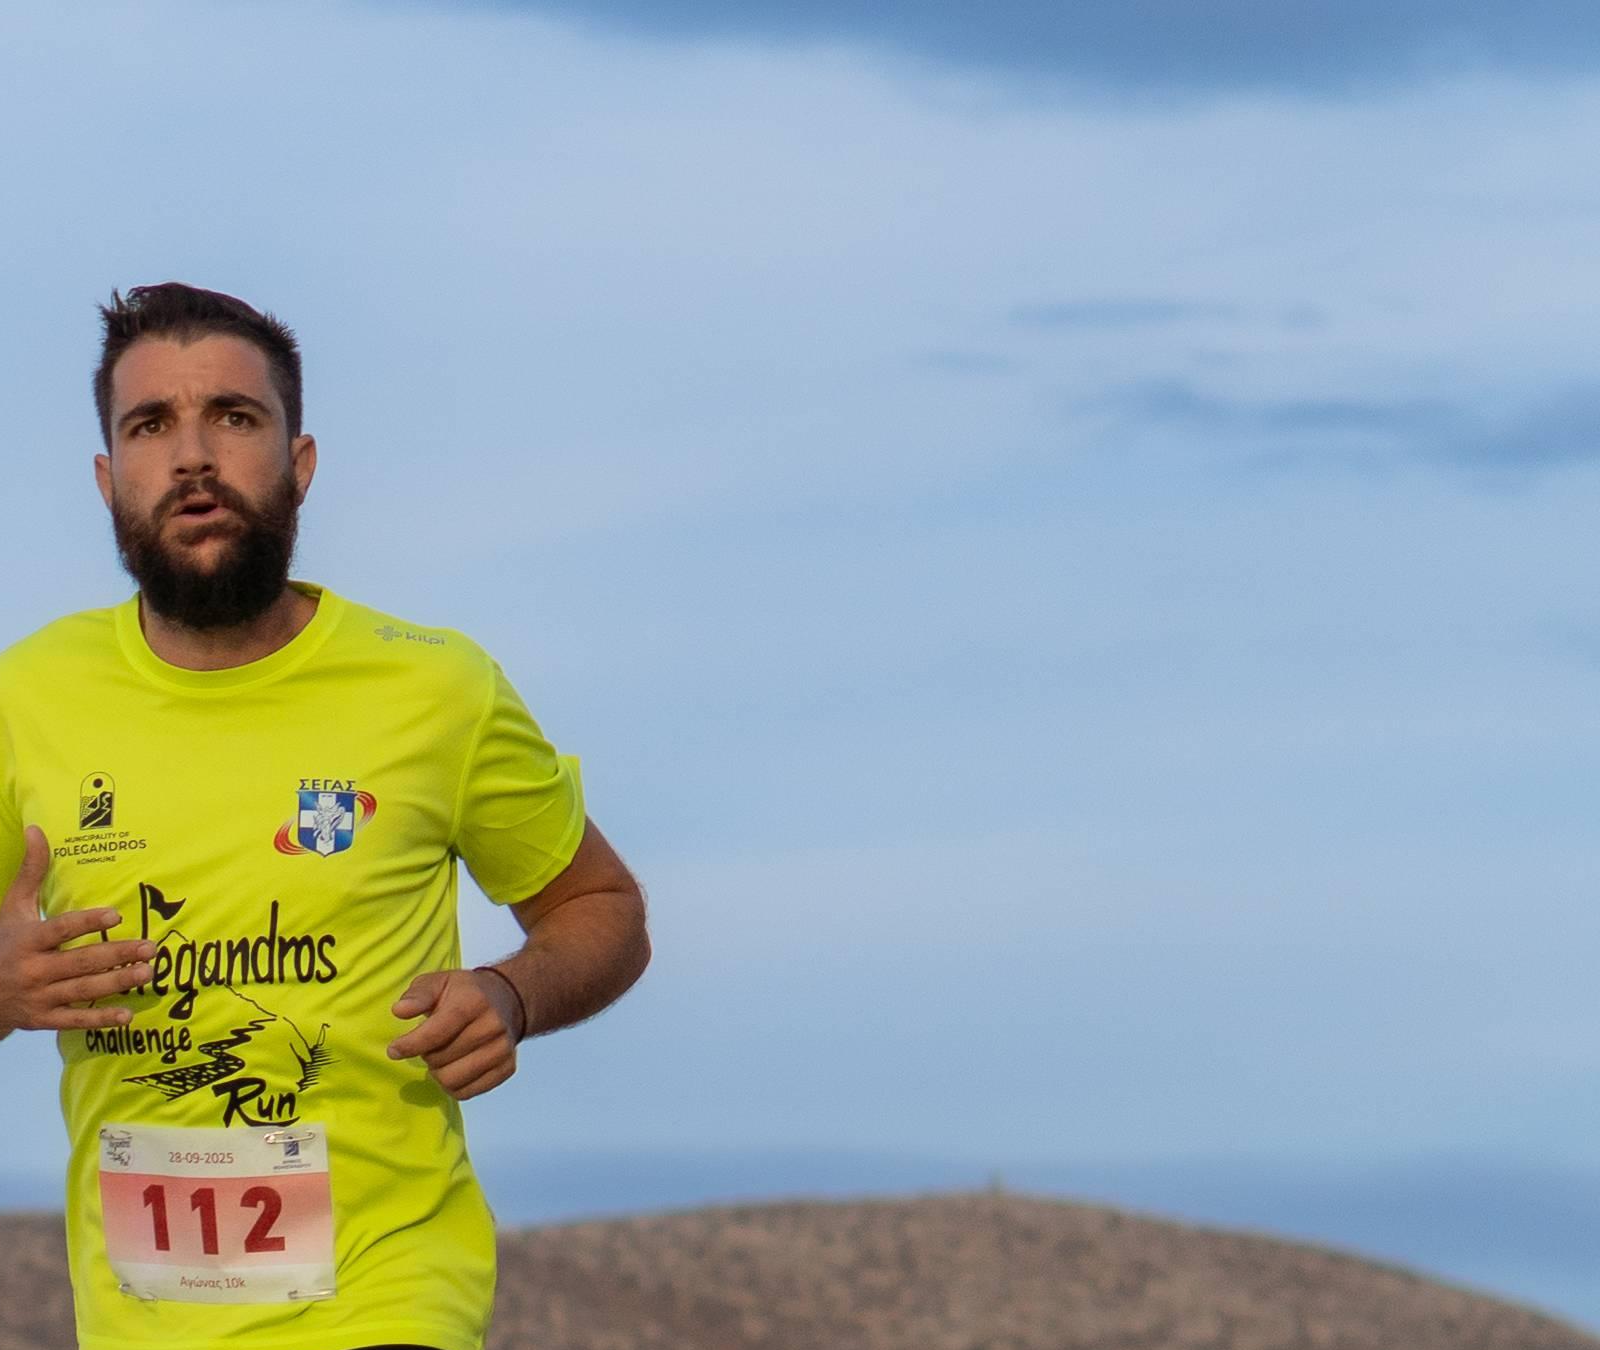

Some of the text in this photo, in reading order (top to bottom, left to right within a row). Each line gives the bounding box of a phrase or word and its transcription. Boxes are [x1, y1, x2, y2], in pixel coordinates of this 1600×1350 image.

[406, 631, 445, 645] kilpi
[299, 778, 357, 791] ΣΕΓΑΣ
[64, 831, 130, 843] MUNICIPALITY OF
[53, 838, 148, 858] FOLEGANDROS
[85, 1023, 192, 1064] challenge
[211, 1077, 301, 1128] Run
[167, 1151, 234, 1164] 28-09-2025
[142, 1184, 286, 1256] 112
[180, 1275, 247, 1291] Αγώνας 10k
